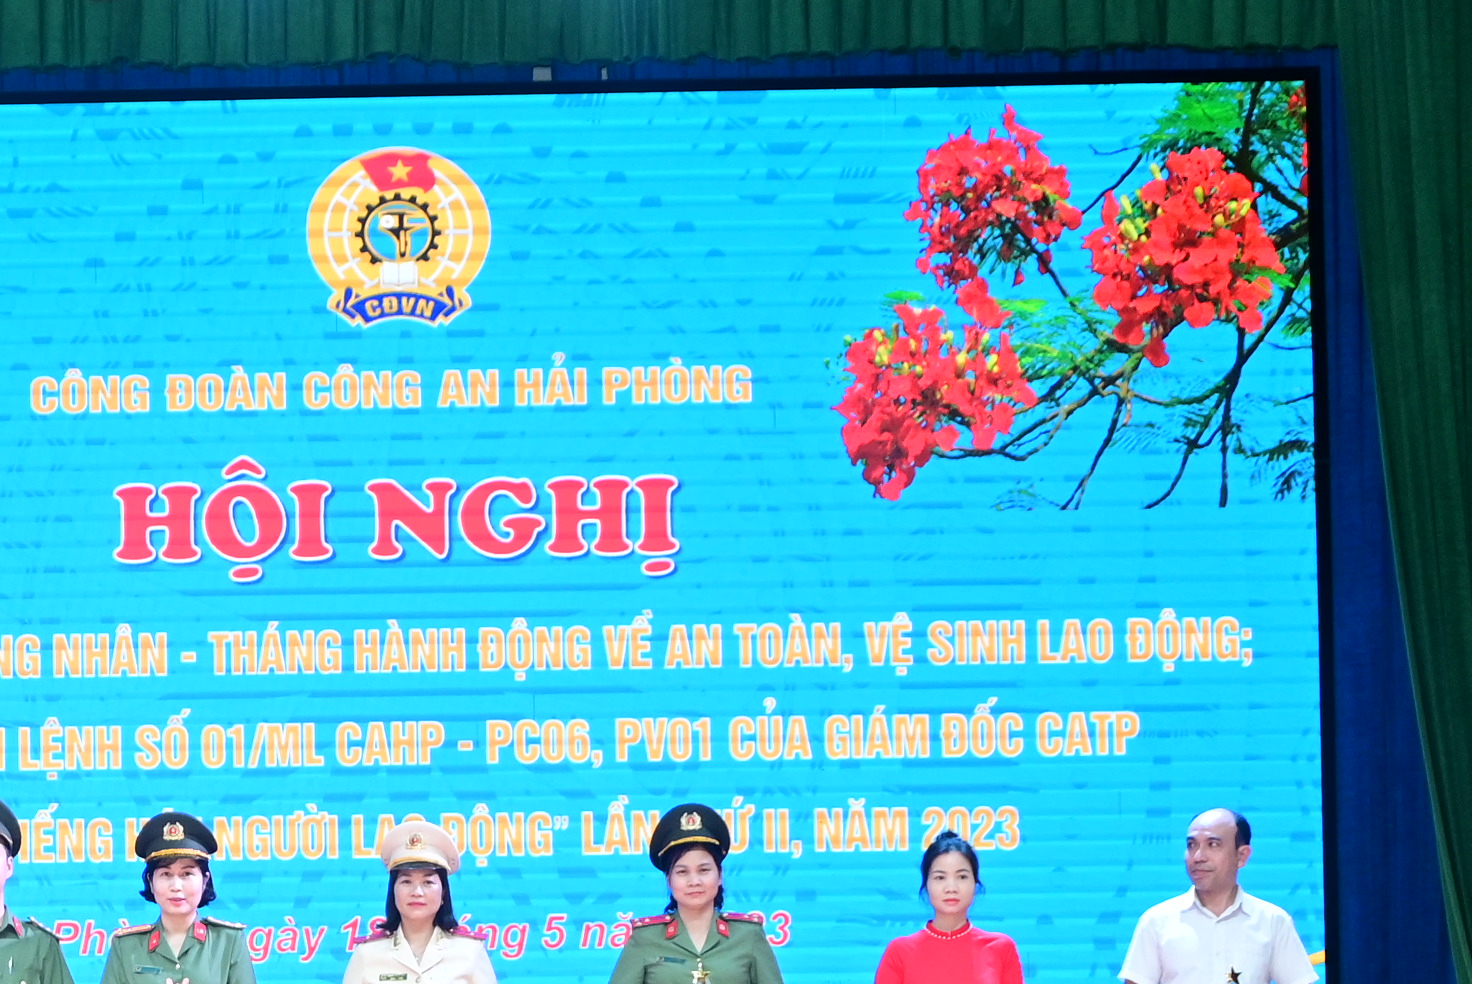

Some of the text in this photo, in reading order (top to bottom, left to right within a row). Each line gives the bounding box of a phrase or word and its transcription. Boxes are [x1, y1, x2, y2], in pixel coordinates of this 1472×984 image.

[31, 353, 752, 414] CÔNG ĐOÀN CÔNG AN HẢI PHÒNG
[113, 455, 680, 582] HỘI NGHỊ
[53, 624, 168, 678] NHÂN
[181, 652, 196, 662] -
[208, 621, 342, 675] THÁNG
[354, 620, 466, 673] HÀNH
[478, 618, 591, 681] ĐỘNG
[603, 610, 653, 669] VỀ
[665, 624, 722, 668] AN
[734, 614, 853, 672] TOÀN,
[864, 612, 913, 675] VỆ
[928, 620, 1026, 665] SINH
[1038, 619, 1113, 663] LAO
[1126, 608, 1252, 671] ĐỘNG;
[19, 717, 122, 780] LỆNH
[135, 709, 191, 770] SỐ
[201, 723, 324, 768] 01/ML
[336, 721, 445, 766] CAHP
[458, 741, 473, 751] -
[487, 719, 603, 767] PC06,
[616, 718, 711, 762] PV01
[729, 697, 812, 761] CỦA
[825, 705, 930, 759] GIÁM
[941, 697, 1024, 757] ĐỐC
[1037, 711, 1140, 756] CATP
[17, 803, 113, 863] IẾNG
[212, 803, 339, 861] NGƯỜI
[352, 813, 426, 858] LA
[581, 795, 660, 855] LẦN
[764, 809, 802, 858] II,
[815, 798, 909, 852] NĂM
[922, 806, 1020, 851] 2023
[245, 915, 328, 962] gày
[542, 913, 568, 950] 5
[581, 912, 632, 949] nă
